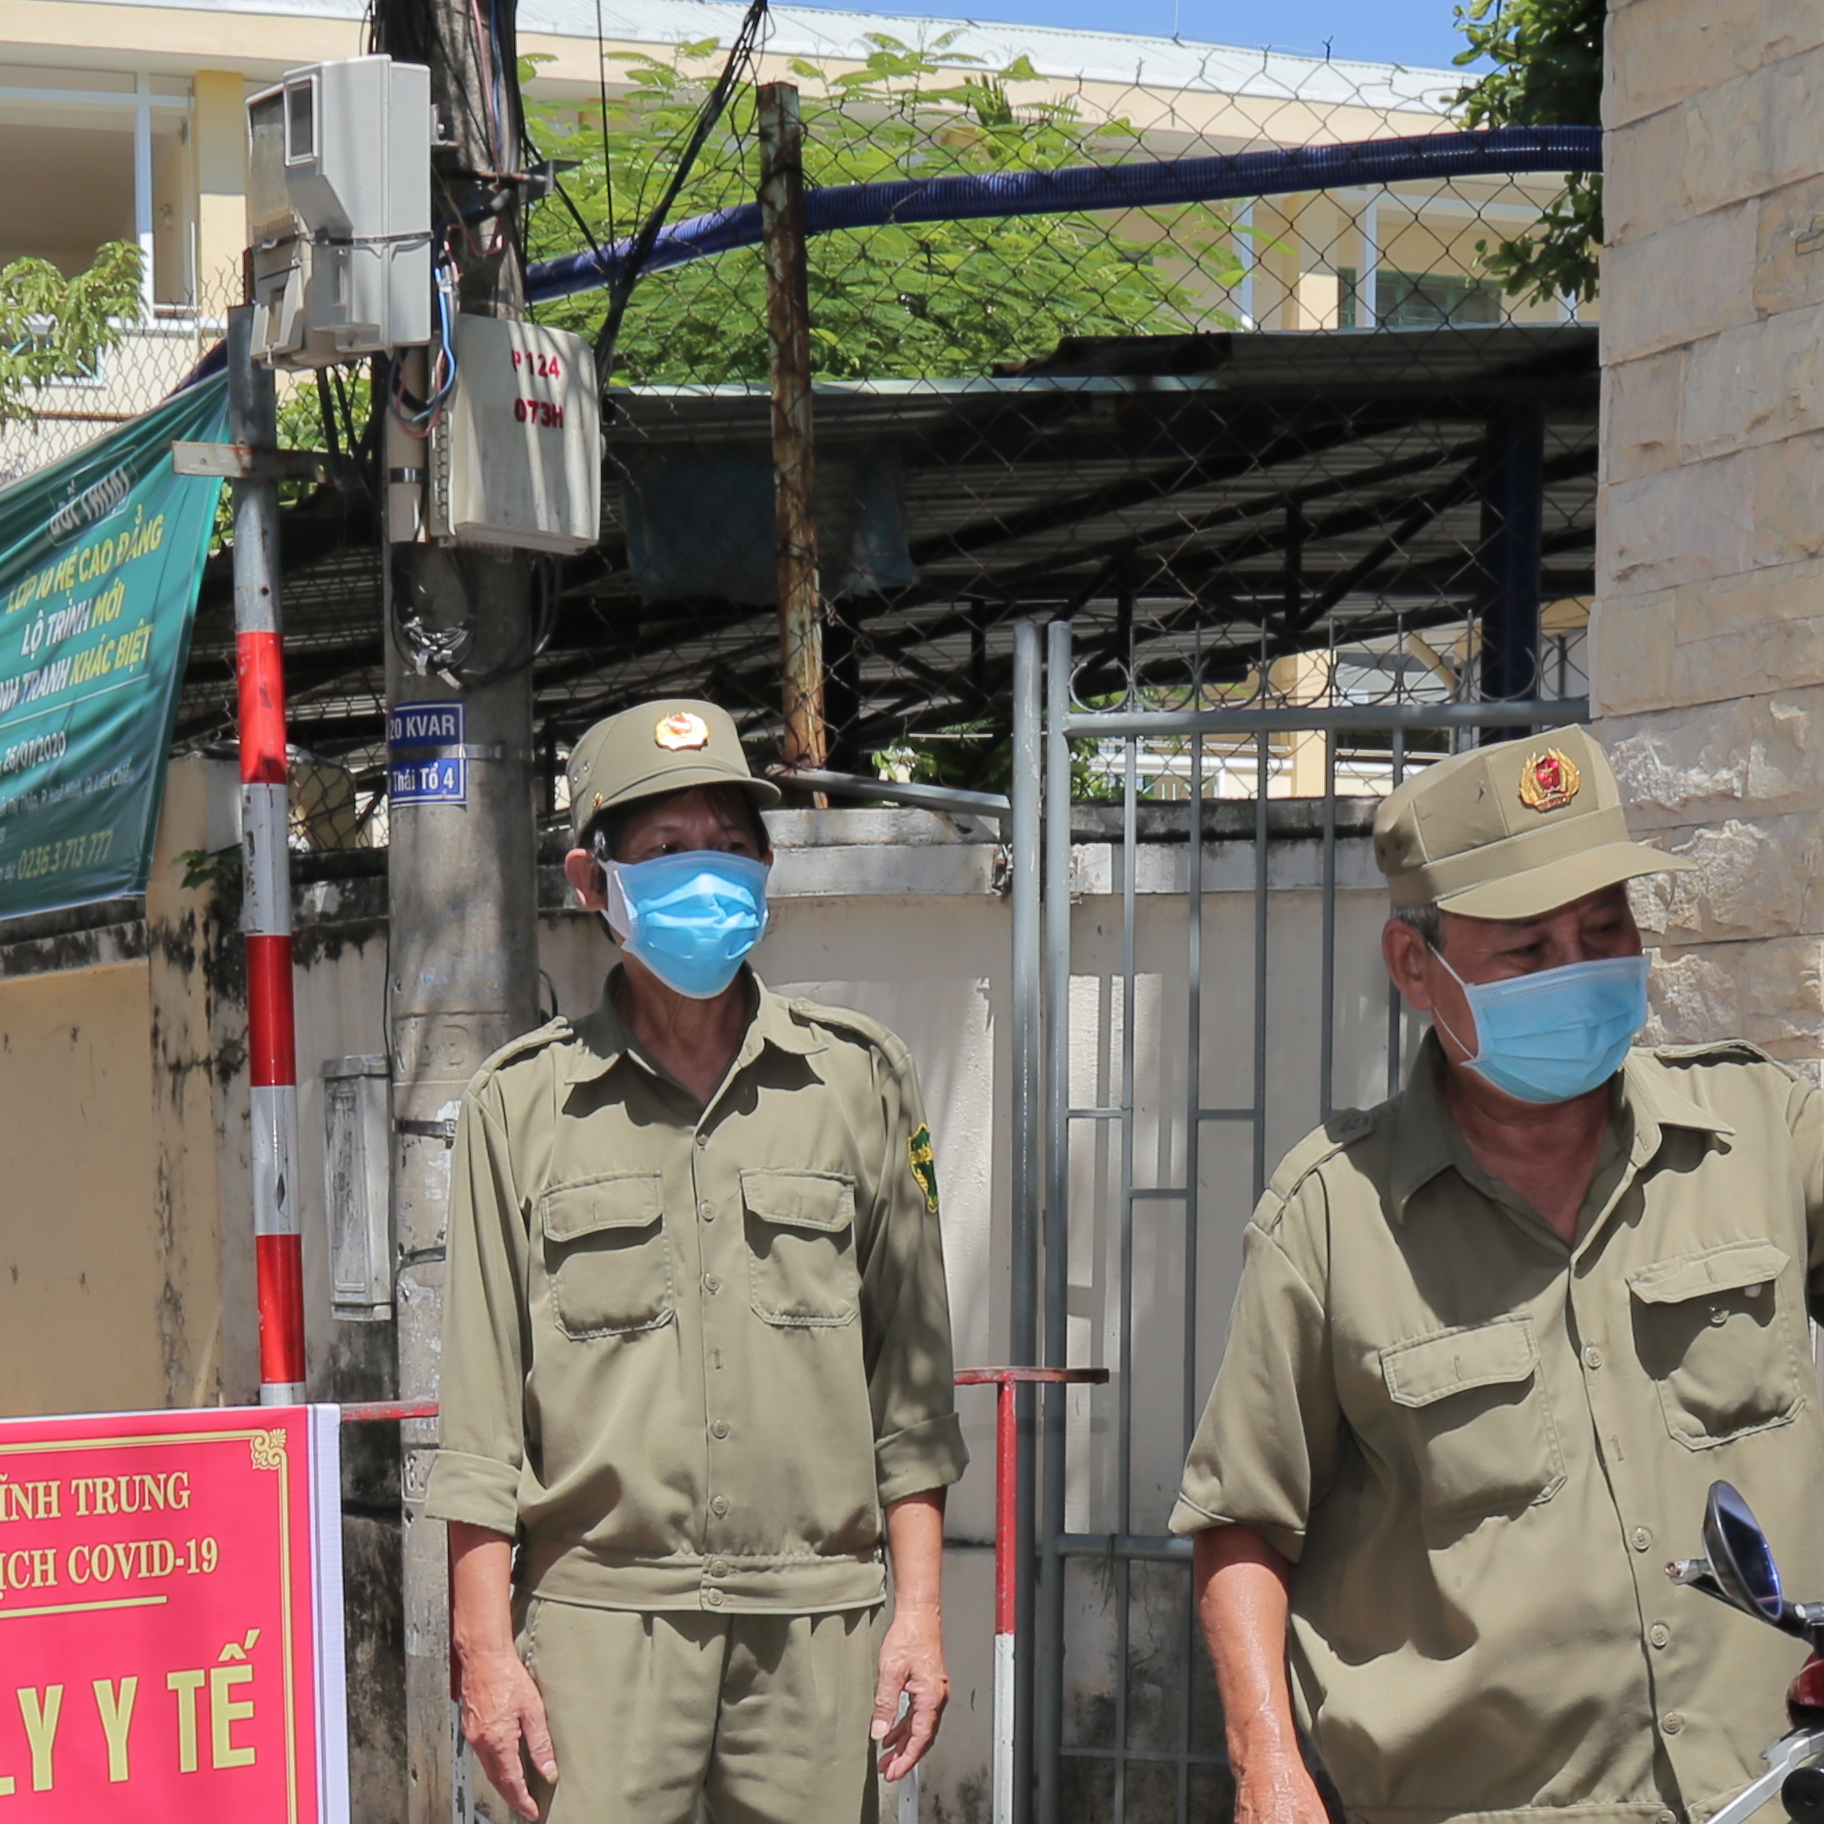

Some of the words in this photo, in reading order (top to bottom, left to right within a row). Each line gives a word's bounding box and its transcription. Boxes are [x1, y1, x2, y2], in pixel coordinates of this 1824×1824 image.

[514, 397, 564, 429] 073H
[53, 547, 79, 597] HỆ
[78, 538, 114, 583] CAO
[115, 504, 165, 565] ĐẲNG
[20, 609, 45, 660] LỘ
[45, 597, 93, 647] TRÌNH
[91, 578, 126, 628] MỚI
[20, 656, 72, 704] TRANH
[69, 633, 116, 687] KHÁC
[114, 618, 155, 673] BIỆT
[406, 714, 455, 738] KVAR
[3, 731, 67, 774] 26/07/2020
[392, 768, 416, 792] Thái
[419, 762, 439, 790] Tổ
[443, 766, 455, 789] 4
[70, 1471, 192, 1516] TRUNG
[66, 1536, 219, 1586] COVID-19
[93, 1676, 139, 1783] Y
[166, 1628, 262, 1774] TẾ
